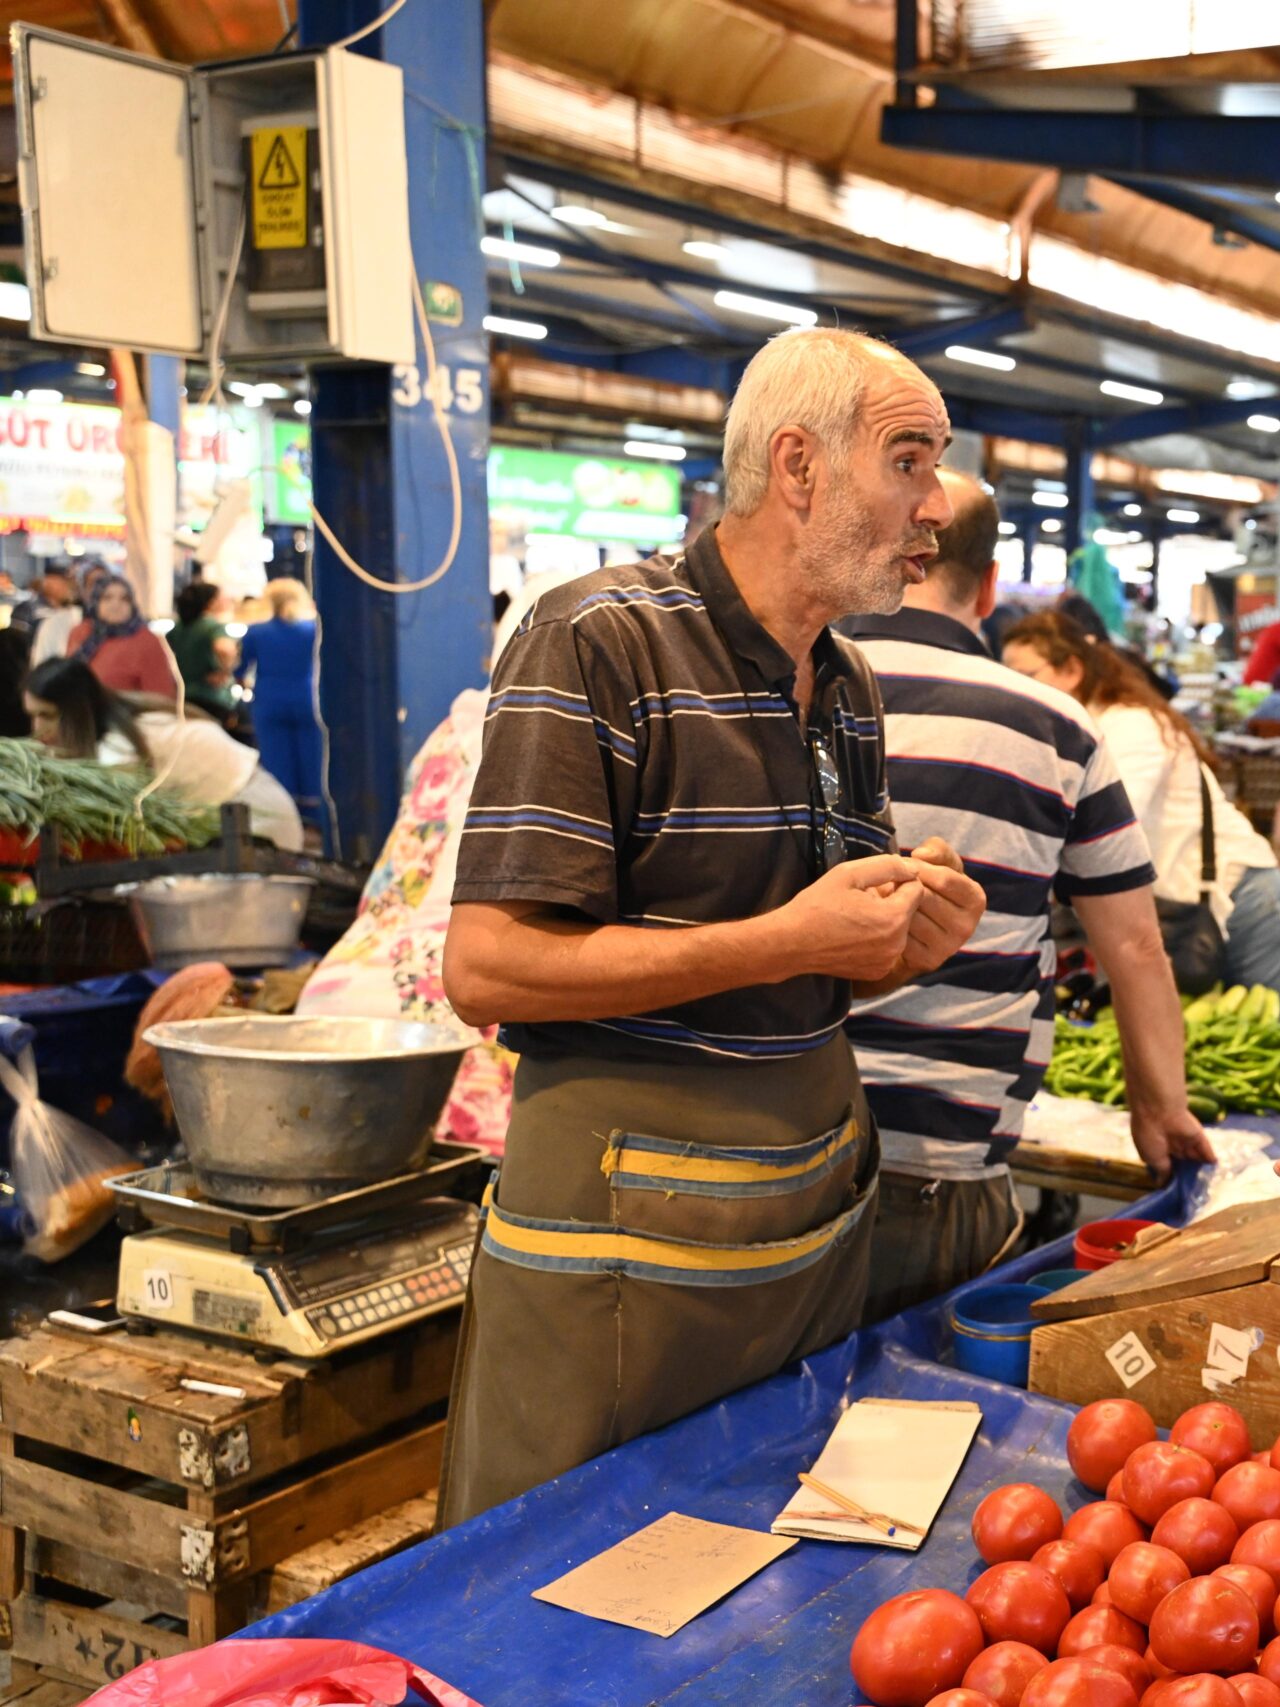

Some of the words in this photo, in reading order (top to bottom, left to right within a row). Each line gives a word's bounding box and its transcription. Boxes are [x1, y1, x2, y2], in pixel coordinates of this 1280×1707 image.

[392, 363, 483, 413] 345
[147, 1276, 169, 1301] 10
[1114, 1341, 1145, 1377] 10
